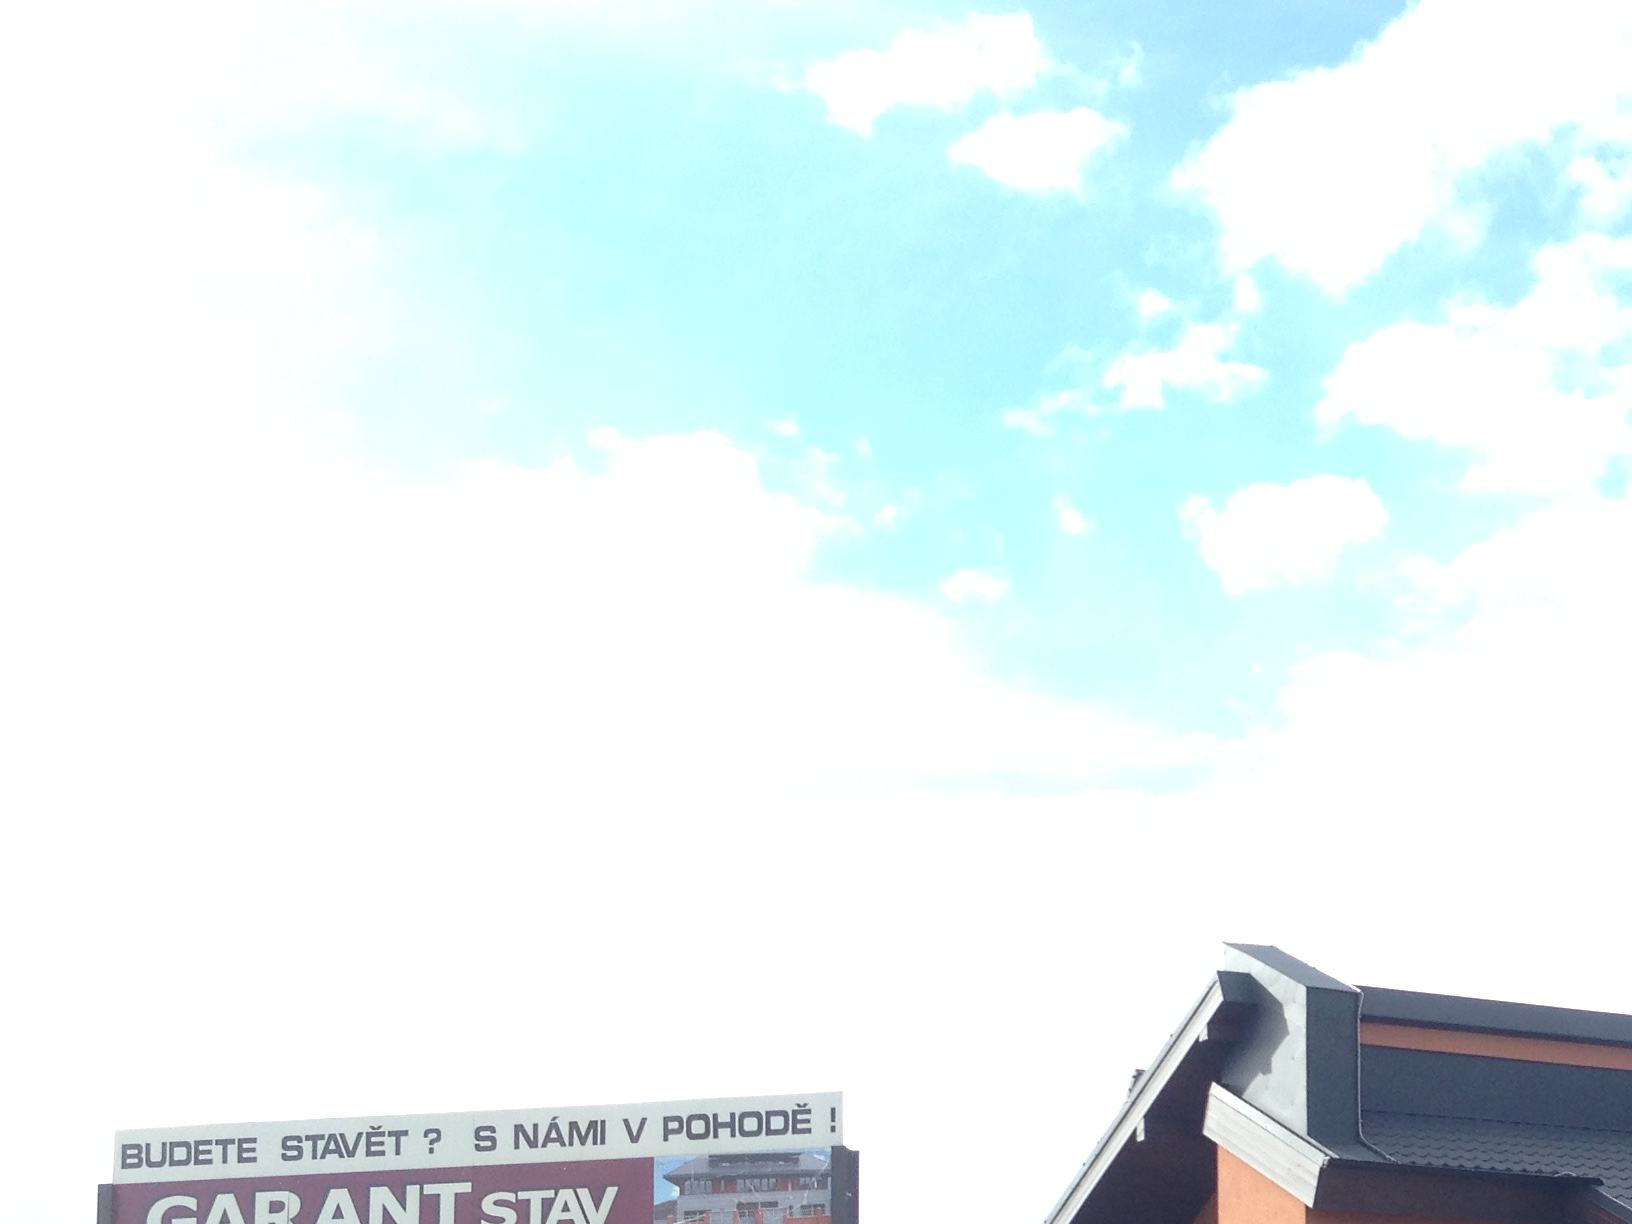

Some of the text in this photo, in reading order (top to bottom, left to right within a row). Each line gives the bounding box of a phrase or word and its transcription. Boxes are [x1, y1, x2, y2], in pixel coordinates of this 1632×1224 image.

[121, 1103, 836, 1169] BUDETE STAVĚT ? S NÁMI V POHODĚ !
